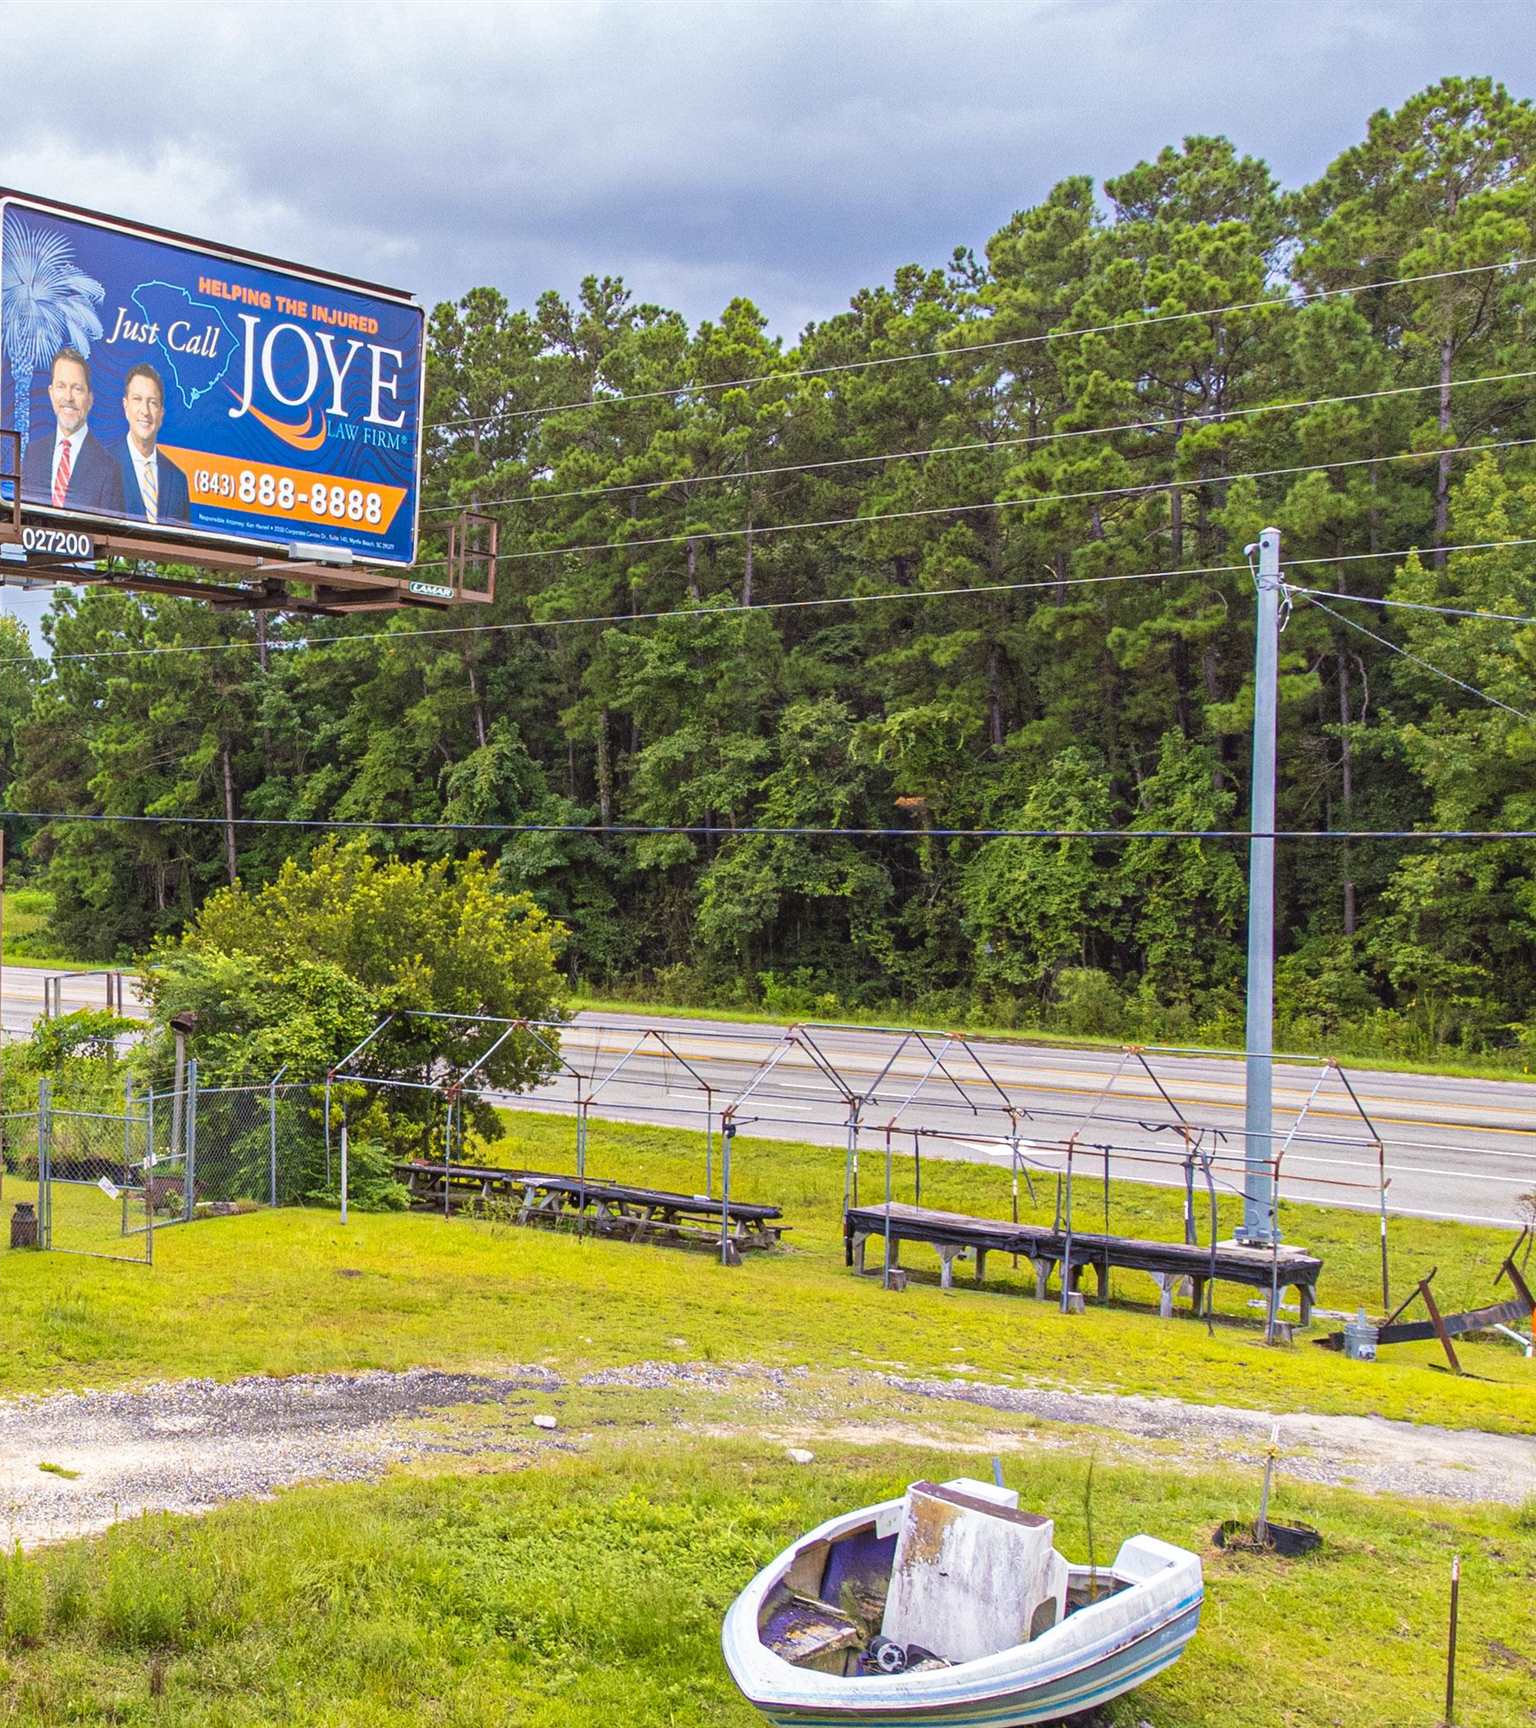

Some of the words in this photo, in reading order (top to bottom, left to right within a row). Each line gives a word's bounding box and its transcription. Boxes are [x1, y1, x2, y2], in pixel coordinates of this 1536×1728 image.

[198, 276, 272, 309] HELPING
[275, 296, 308, 318] THE
[311, 304, 379, 334] INJURED
[106, 307, 161, 344] Just
[167, 320, 221, 358] Call
[228, 313, 406, 428] JOYE
[327, 420, 359, 441] LAW
[194, 469, 235, 498] (843)
[238, 470, 382, 524] 888-8888
[22, 527, 90, 556] 027200
[413, 583, 451, 596] LAMAR
